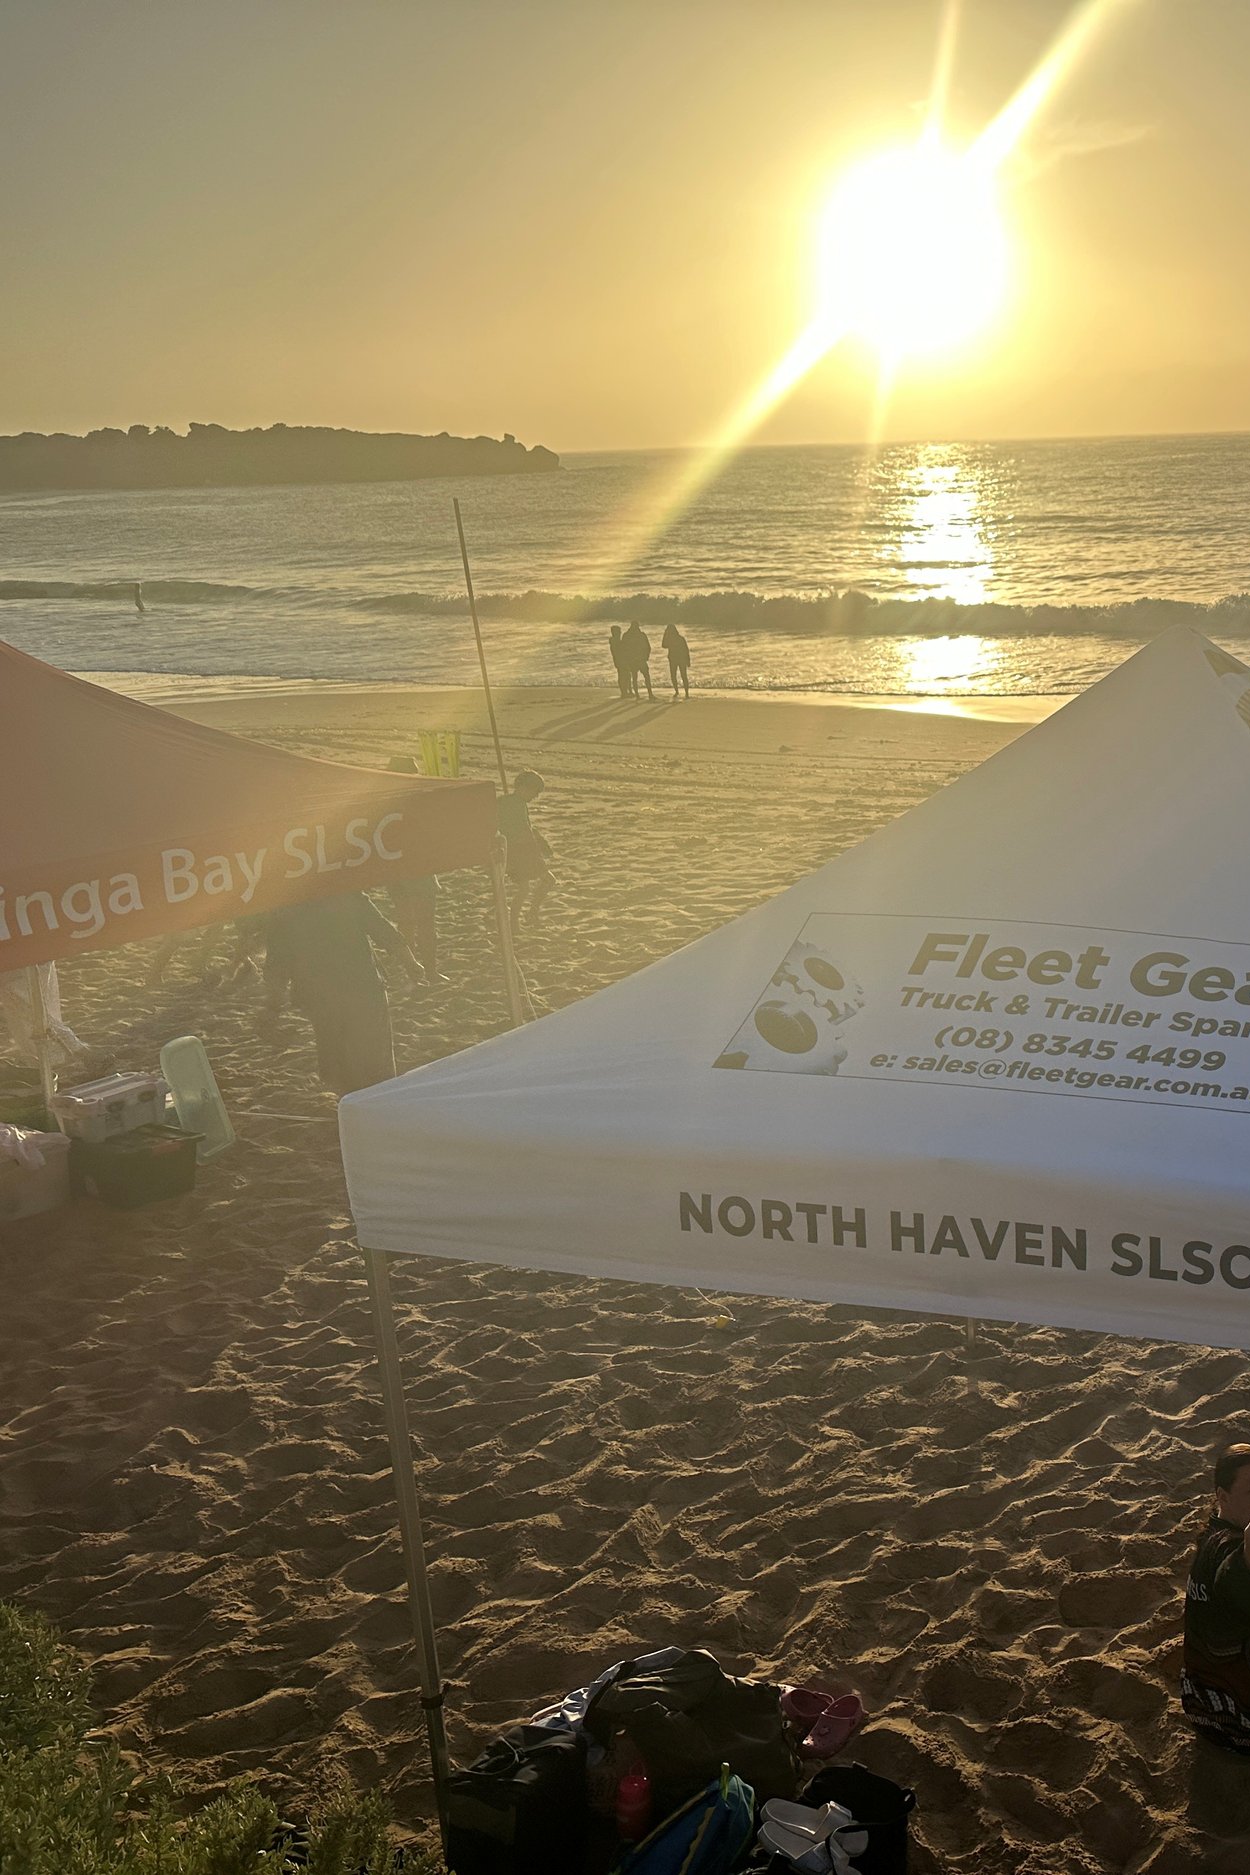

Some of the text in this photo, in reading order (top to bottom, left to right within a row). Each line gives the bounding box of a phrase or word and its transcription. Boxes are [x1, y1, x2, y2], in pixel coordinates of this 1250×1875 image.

[162, 847, 267, 903] Bay
[283, 813, 404, 879] SLSC
[907, 932, 1109, 990] Fleet
[900, 986, 997, 1015] Truck
[1005, 994, 1029, 1017] &
[1043, 996, 1160, 1029] Trailer
[869, 1050, 896, 1069] e:
[933, 1024, 1227, 1071] (08) 8345 4499
[679, 1191, 867, 1248] NORTH
[890, 1210, 1087, 1271] HAVEN
